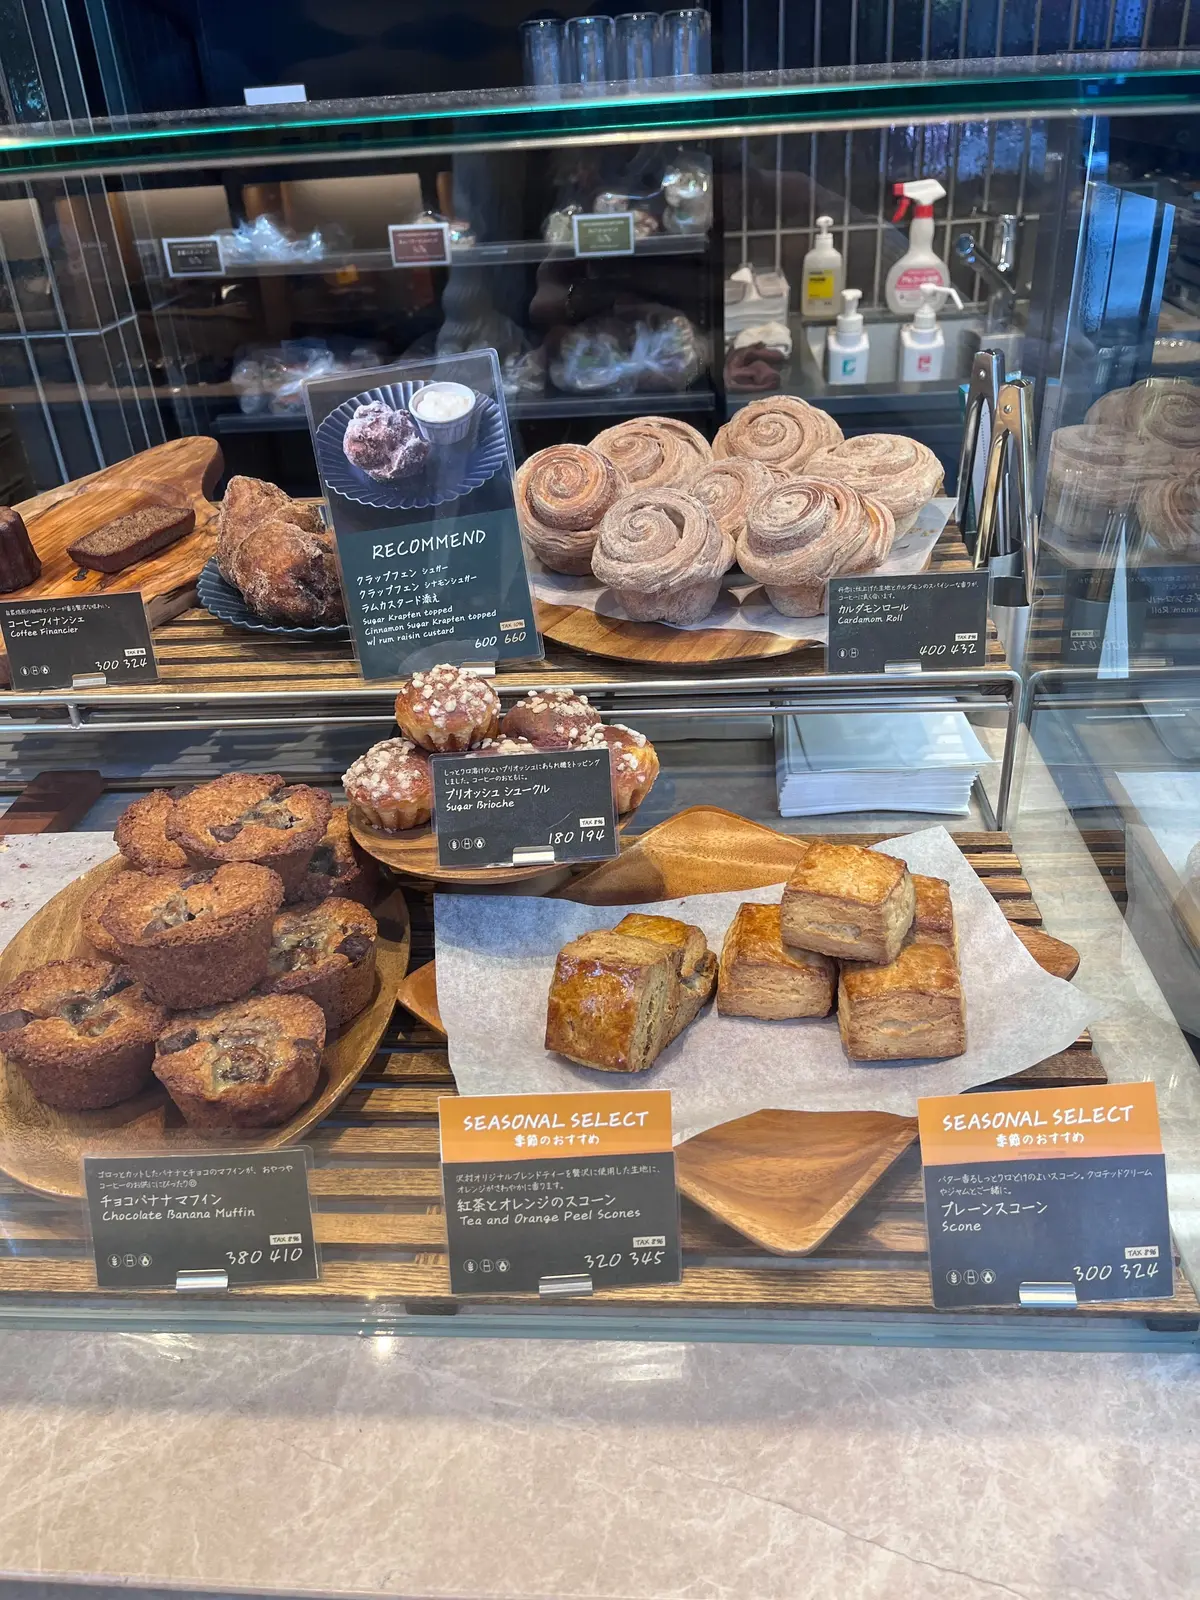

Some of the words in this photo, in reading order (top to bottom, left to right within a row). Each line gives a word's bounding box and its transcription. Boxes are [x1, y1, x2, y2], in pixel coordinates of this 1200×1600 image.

[372, 530, 486, 560] RECOMMEND
[357, 570, 417, 585] クラップフェン
[422, 565, 448, 574] シュガー
[360, 583, 419, 599] クラップフェン
[425, 575, 477, 588] シナモンシュガー
[362, 593, 440, 613] ラムカスタード添え
[839, 604, 909, 614] カルダモンロール
[8, 616, 85, 628] コーヒーフィナンシェ
[363, 617, 385, 625] Sugar
[389, 611, 421, 621] Krapfen
[424, 606, 452, 617] topped
[365, 624, 404, 635] Cinnamon
[407, 621, 429, 630] Sugar
[433, 615, 465, 625] Krapfen
[468, 610, 496, 622] topped
[838, 615, 882, 624] Cardamom
[886, 614, 903, 622] Roll
[11, 629, 38, 638] Coffee
[40, 626, 78, 635] Financier
[379, 636, 394, 644] rum
[397, 632, 420, 641] raisin
[423, 627, 454, 638] custard
[475, 636, 497, 648] 600
[505, 631, 526, 643] 660
[919, 644, 946, 655] 400
[951, 644, 976, 654] 432
[95, 660, 119, 670] 300
[124, 658, 147, 669] 324
[446, 787, 500, 800] ブリオッシュ
[505, 784, 550, 797] シュークル
[447, 803, 473, 812] Sugar
[477, 800, 515, 809] Brioche
[549, 831, 574, 844] 180
[580, 829, 605, 842] 194
[464, 1114, 565, 1131] SEASONAL
[571, 1111, 648, 1127] SELECT
[943, 1113, 1047, 1131] SEASONAL
[1053, 1105, 1134, 1124] SELECT
[514, 1134, 599, 1147] 季節のおすすめ
[996, 1133, 1084, 1147] 季節のおすすめ
[100, 1195, 221, 1207] チョコバナナマフィン
[457, 1194, 616, 1212] 紅茶とオレンジのスコーン
[941, 1201, 1048, 1217] プレーンスコーン
[102, 1210, 162, 1221] Chocolate
[167, 1209, 210, 1219] Banana
[216, 1207, 255, 1218] Muffin
[460, 1216, 482, 1225] Tea
[487, 1215, 509, 1225] and
[514, 1213, 559, 1224] Orange
[564, 1210, 592, 1221] Peel
[598, 1209, 641, 1219] Scones
[942, 1221, 981, 1232] Scone
[226, 1251, 262, 1265] 380
[270, 1248, 303, 1263] 410
[584, 1253, 622, 1268] 320
[629, 1250, 666, 1265] 345
[1073, 1265, 1112, 1282] 300
[1121, 1263, 1158, 1279] 324
